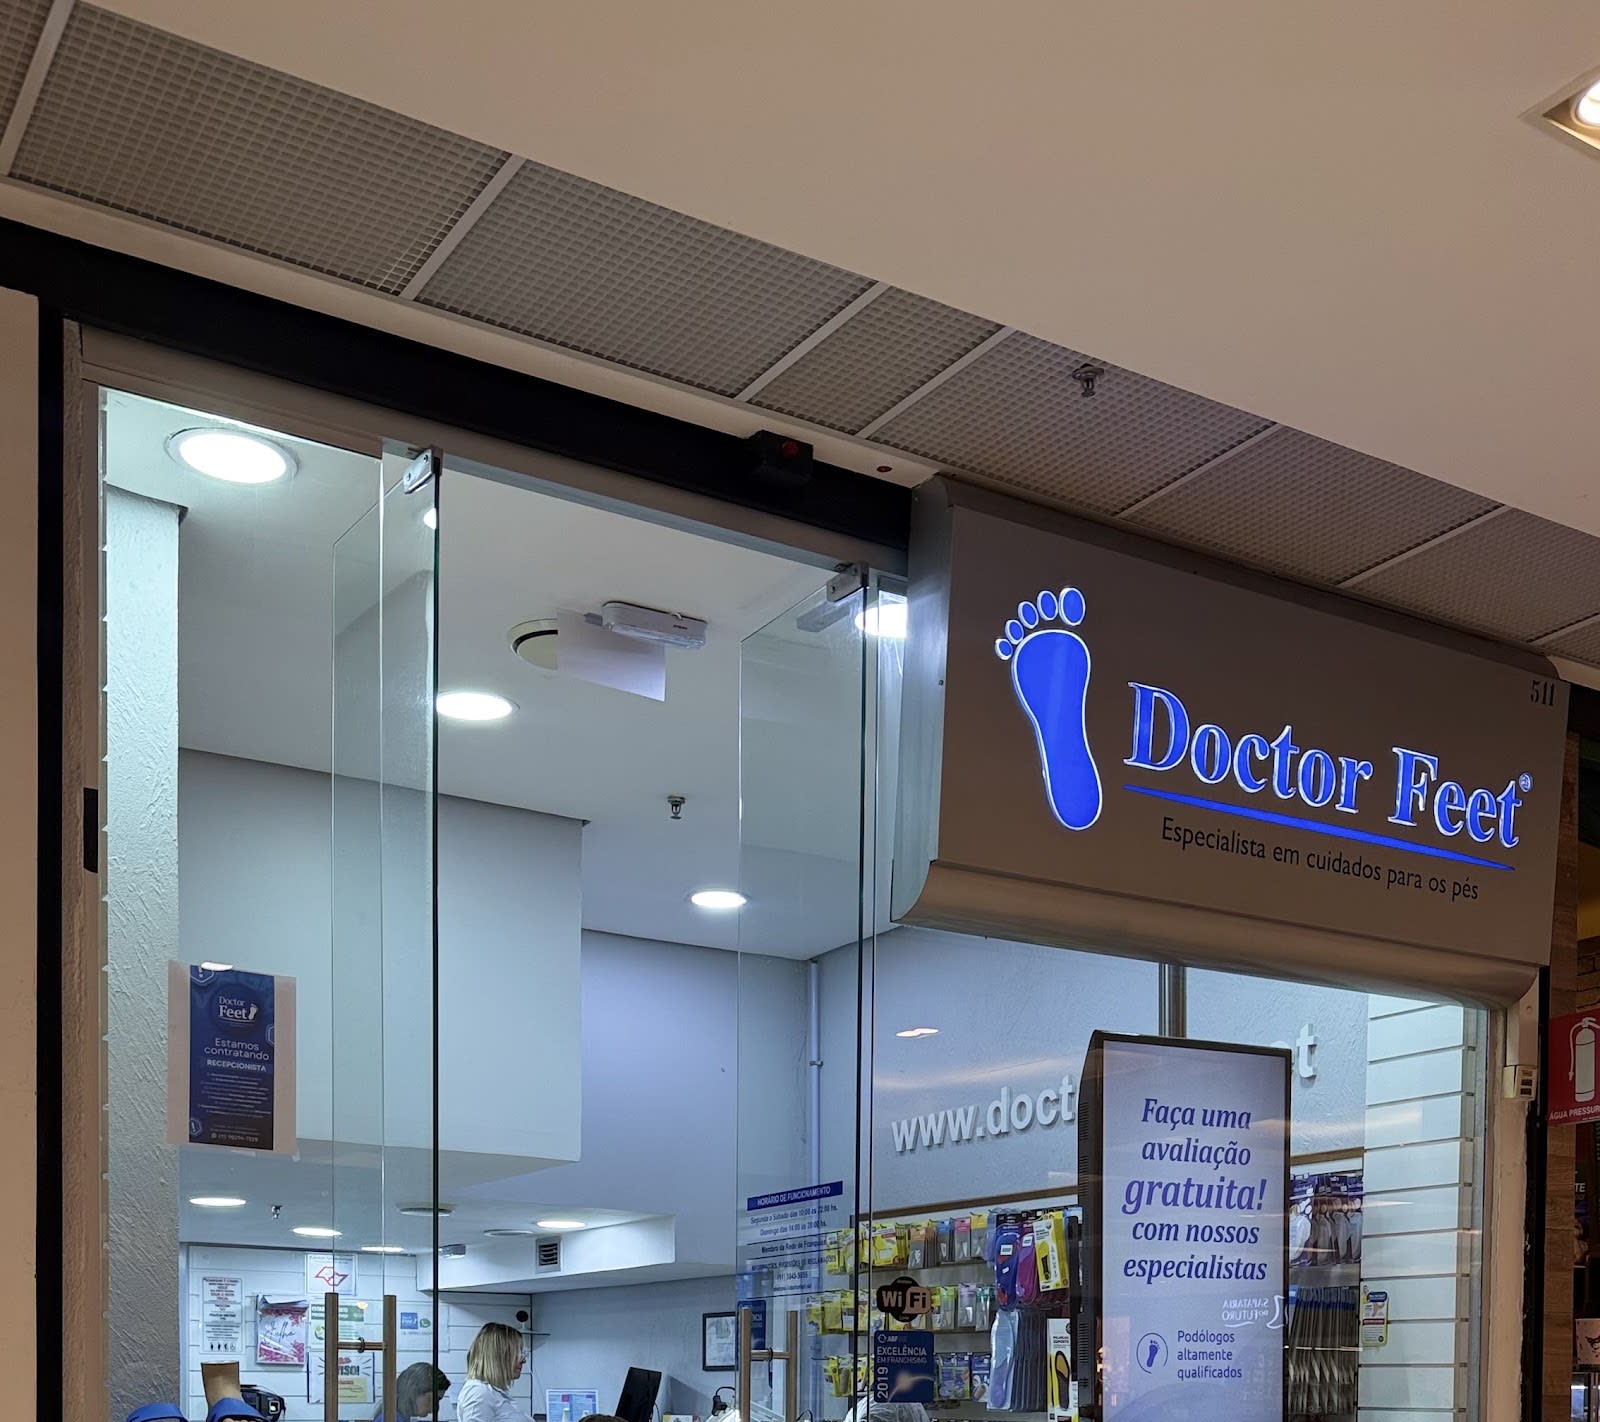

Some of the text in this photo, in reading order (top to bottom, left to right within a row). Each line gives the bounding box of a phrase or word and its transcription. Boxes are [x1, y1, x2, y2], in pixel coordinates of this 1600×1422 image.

[1530, 679, 1555, 707] 511
[1122, 680, 1373, 814] Doctor
[1161, 815, 1479, 903] Especialista em cuidados para os pés
[218, 996, 246, 1006] Doctor
[218, 1005, 248, 1019] Feet
[203, 1046, 270, 1061] contratando
[214, 1037, 260, 1052] Estamos
[207, 1060, 267, 1072] RECEPCIONISTA
[1141, 1097, 1251, 1132] Faça uma
[1549, 1110, 1569, 1121] ÁGUA
[1141, 1137, 1252, 1170] avaliação
[1121, 1176, 1267, 1215] gratuita!
[1131, 1219, 1260, 1245] com nossos
[1122, 1253, 1268, 1285] especialistas
[1176, 1327, 1236, 1347] Podólogos
[876, 1344, 928, 1357] EXCELÊNCIA
[1176, 1347, 1234, 1362] altamente
[876, 1366, 889, 1399] 2019
[1176, 1364, 1243, 1381] qualificados
